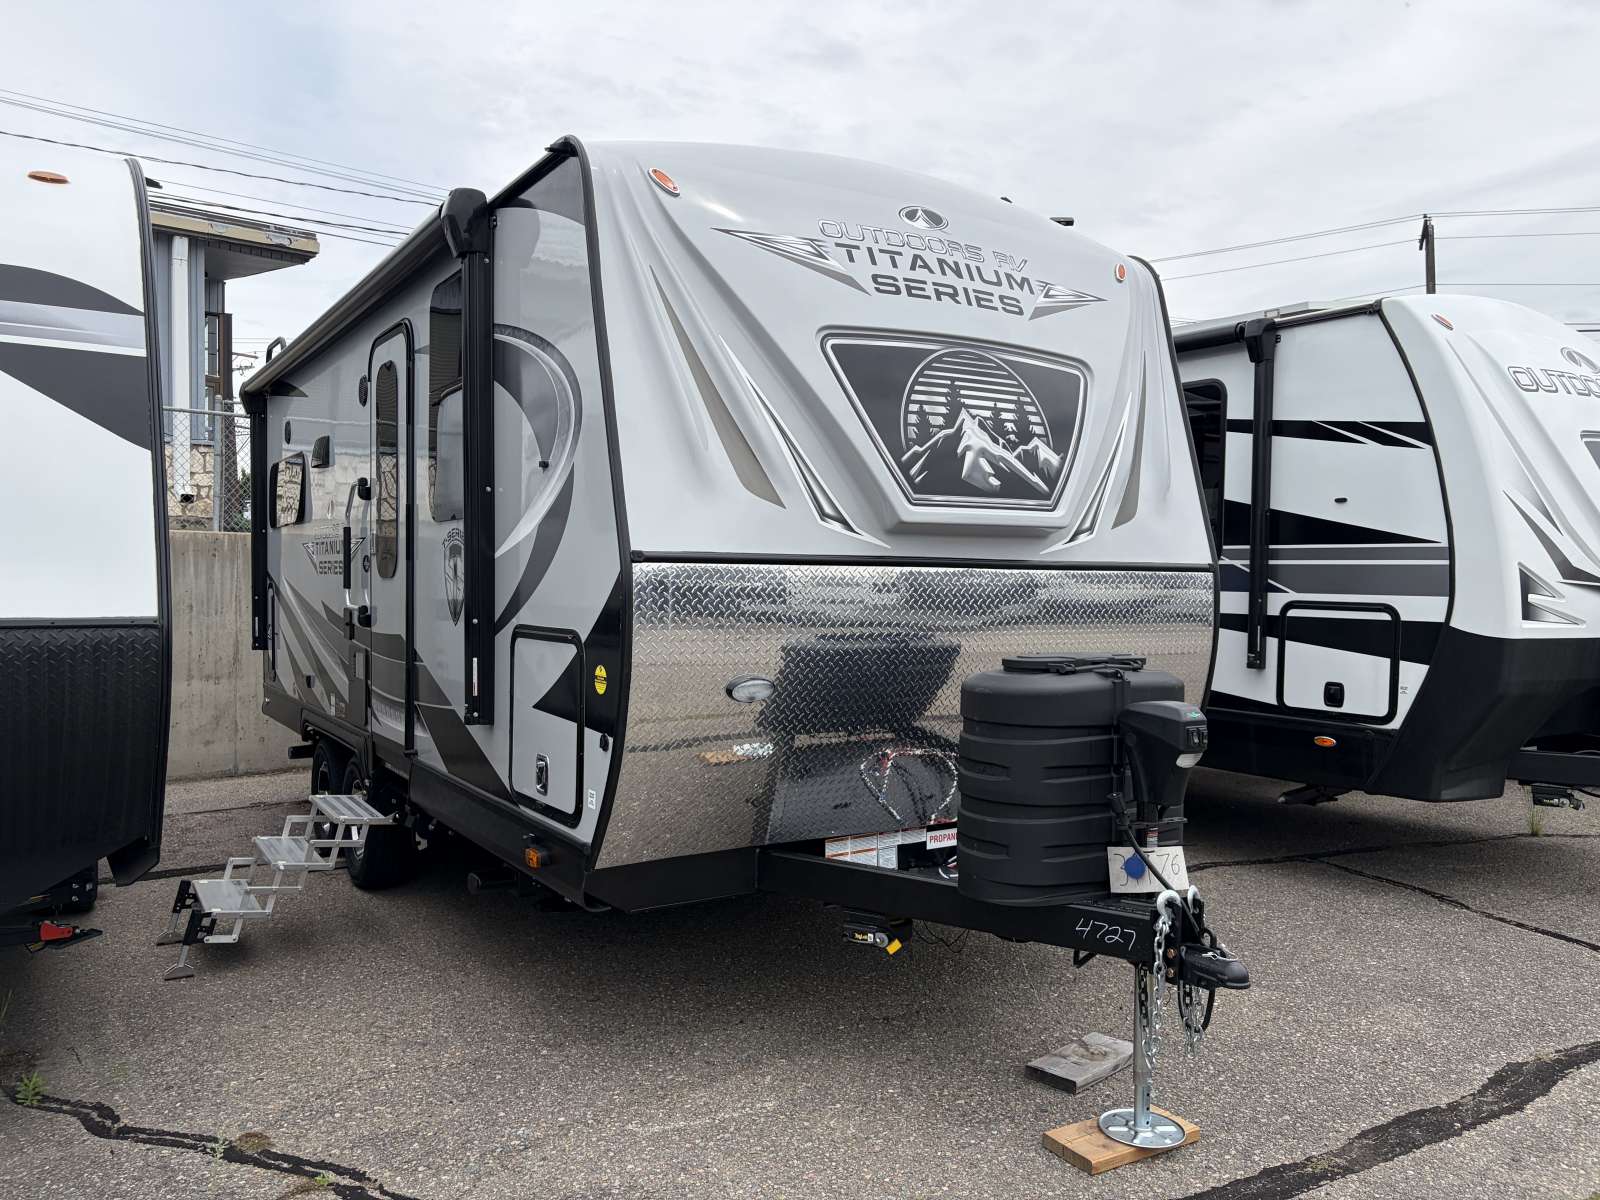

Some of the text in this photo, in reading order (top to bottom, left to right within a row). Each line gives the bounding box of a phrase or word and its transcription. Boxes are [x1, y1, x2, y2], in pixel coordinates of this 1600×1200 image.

[818, 219, 1027, 273] OUTDOORS RV
[834, 242, 1035, 295] TITANIUM
[871, 273, 1026, 317] SERIES
[929, 832, 958, 845] PROPAN
[1075, 917, 1137, 952] 4727
